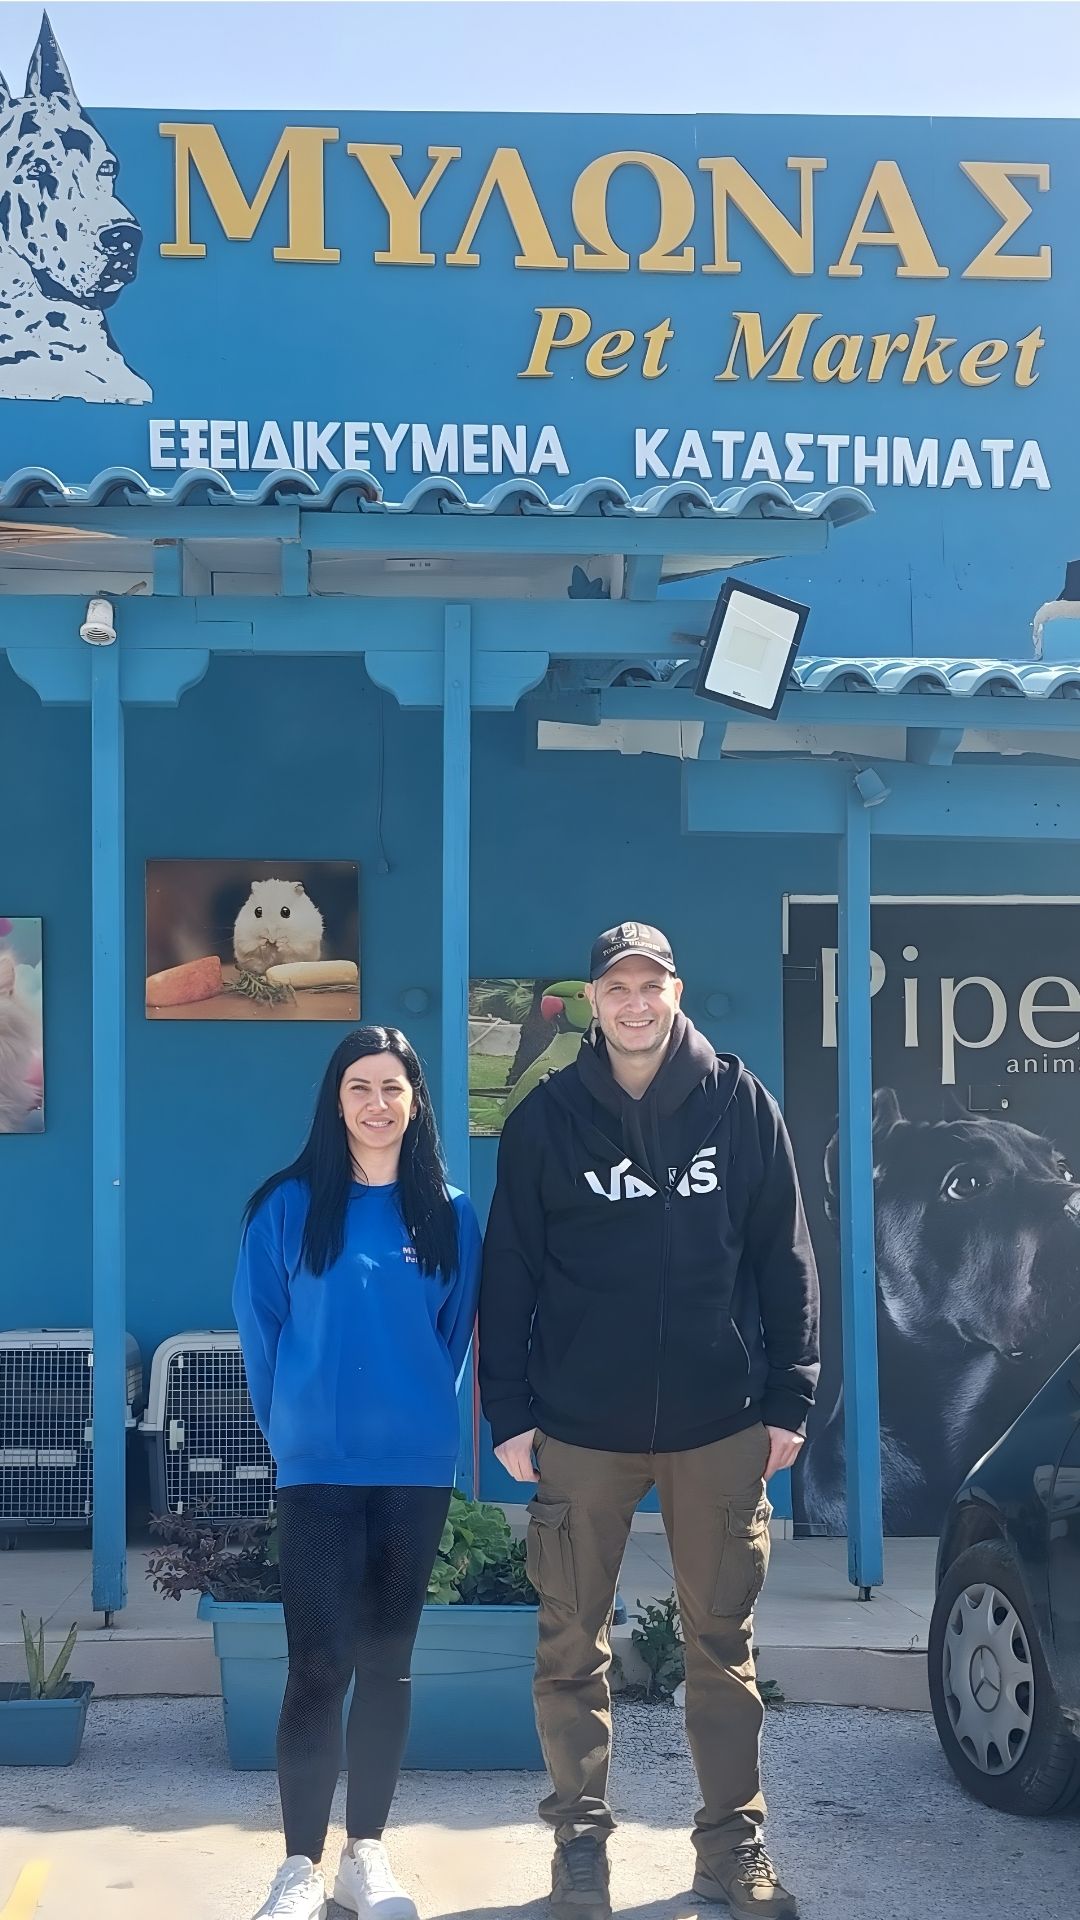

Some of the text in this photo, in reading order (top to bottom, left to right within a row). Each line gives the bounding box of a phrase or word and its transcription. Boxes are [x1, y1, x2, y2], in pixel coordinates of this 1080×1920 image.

[158, 121, 1053, 281] ΜΥΛΩΝΑΣ
[517, 306, 1044, 388] Pet Market
[148, 419, 1052, 491] ΕΞΕΙΔΙΚΕΥΜΕΝΑ ΚΑΤΑΣΤΗΜΑΤΑ
[1006, 1053, 1080, 1073] anim
